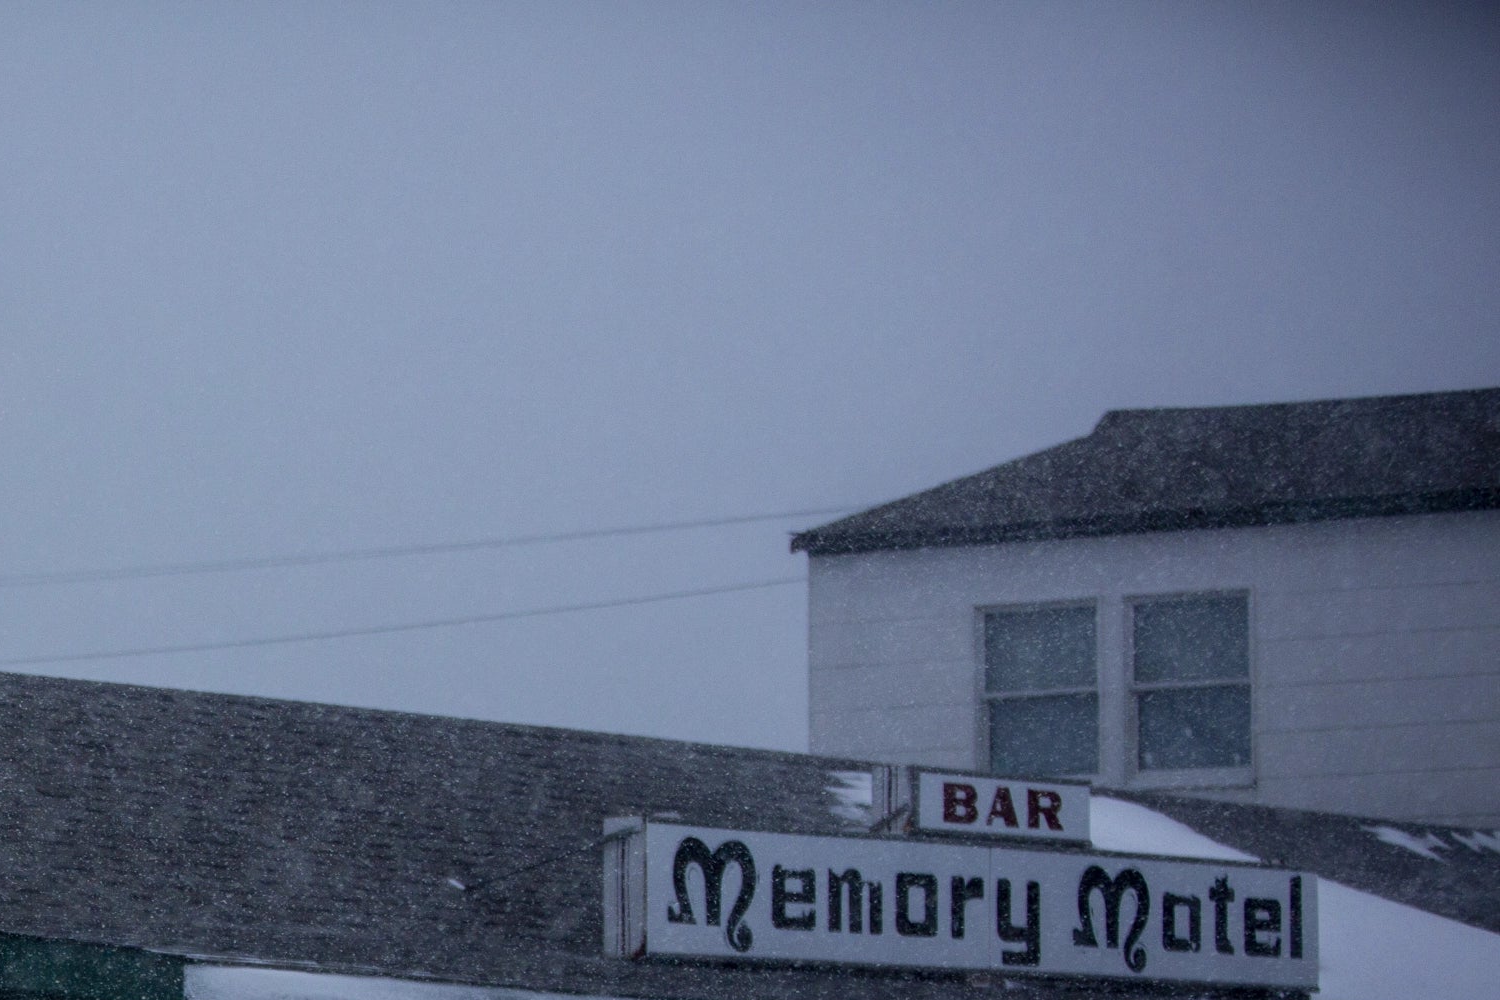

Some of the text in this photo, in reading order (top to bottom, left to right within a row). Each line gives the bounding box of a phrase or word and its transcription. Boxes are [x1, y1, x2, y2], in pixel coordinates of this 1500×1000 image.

[942, 783, 1064, 831] BAR
[667, 836, 1303, 973] Memory Motel
